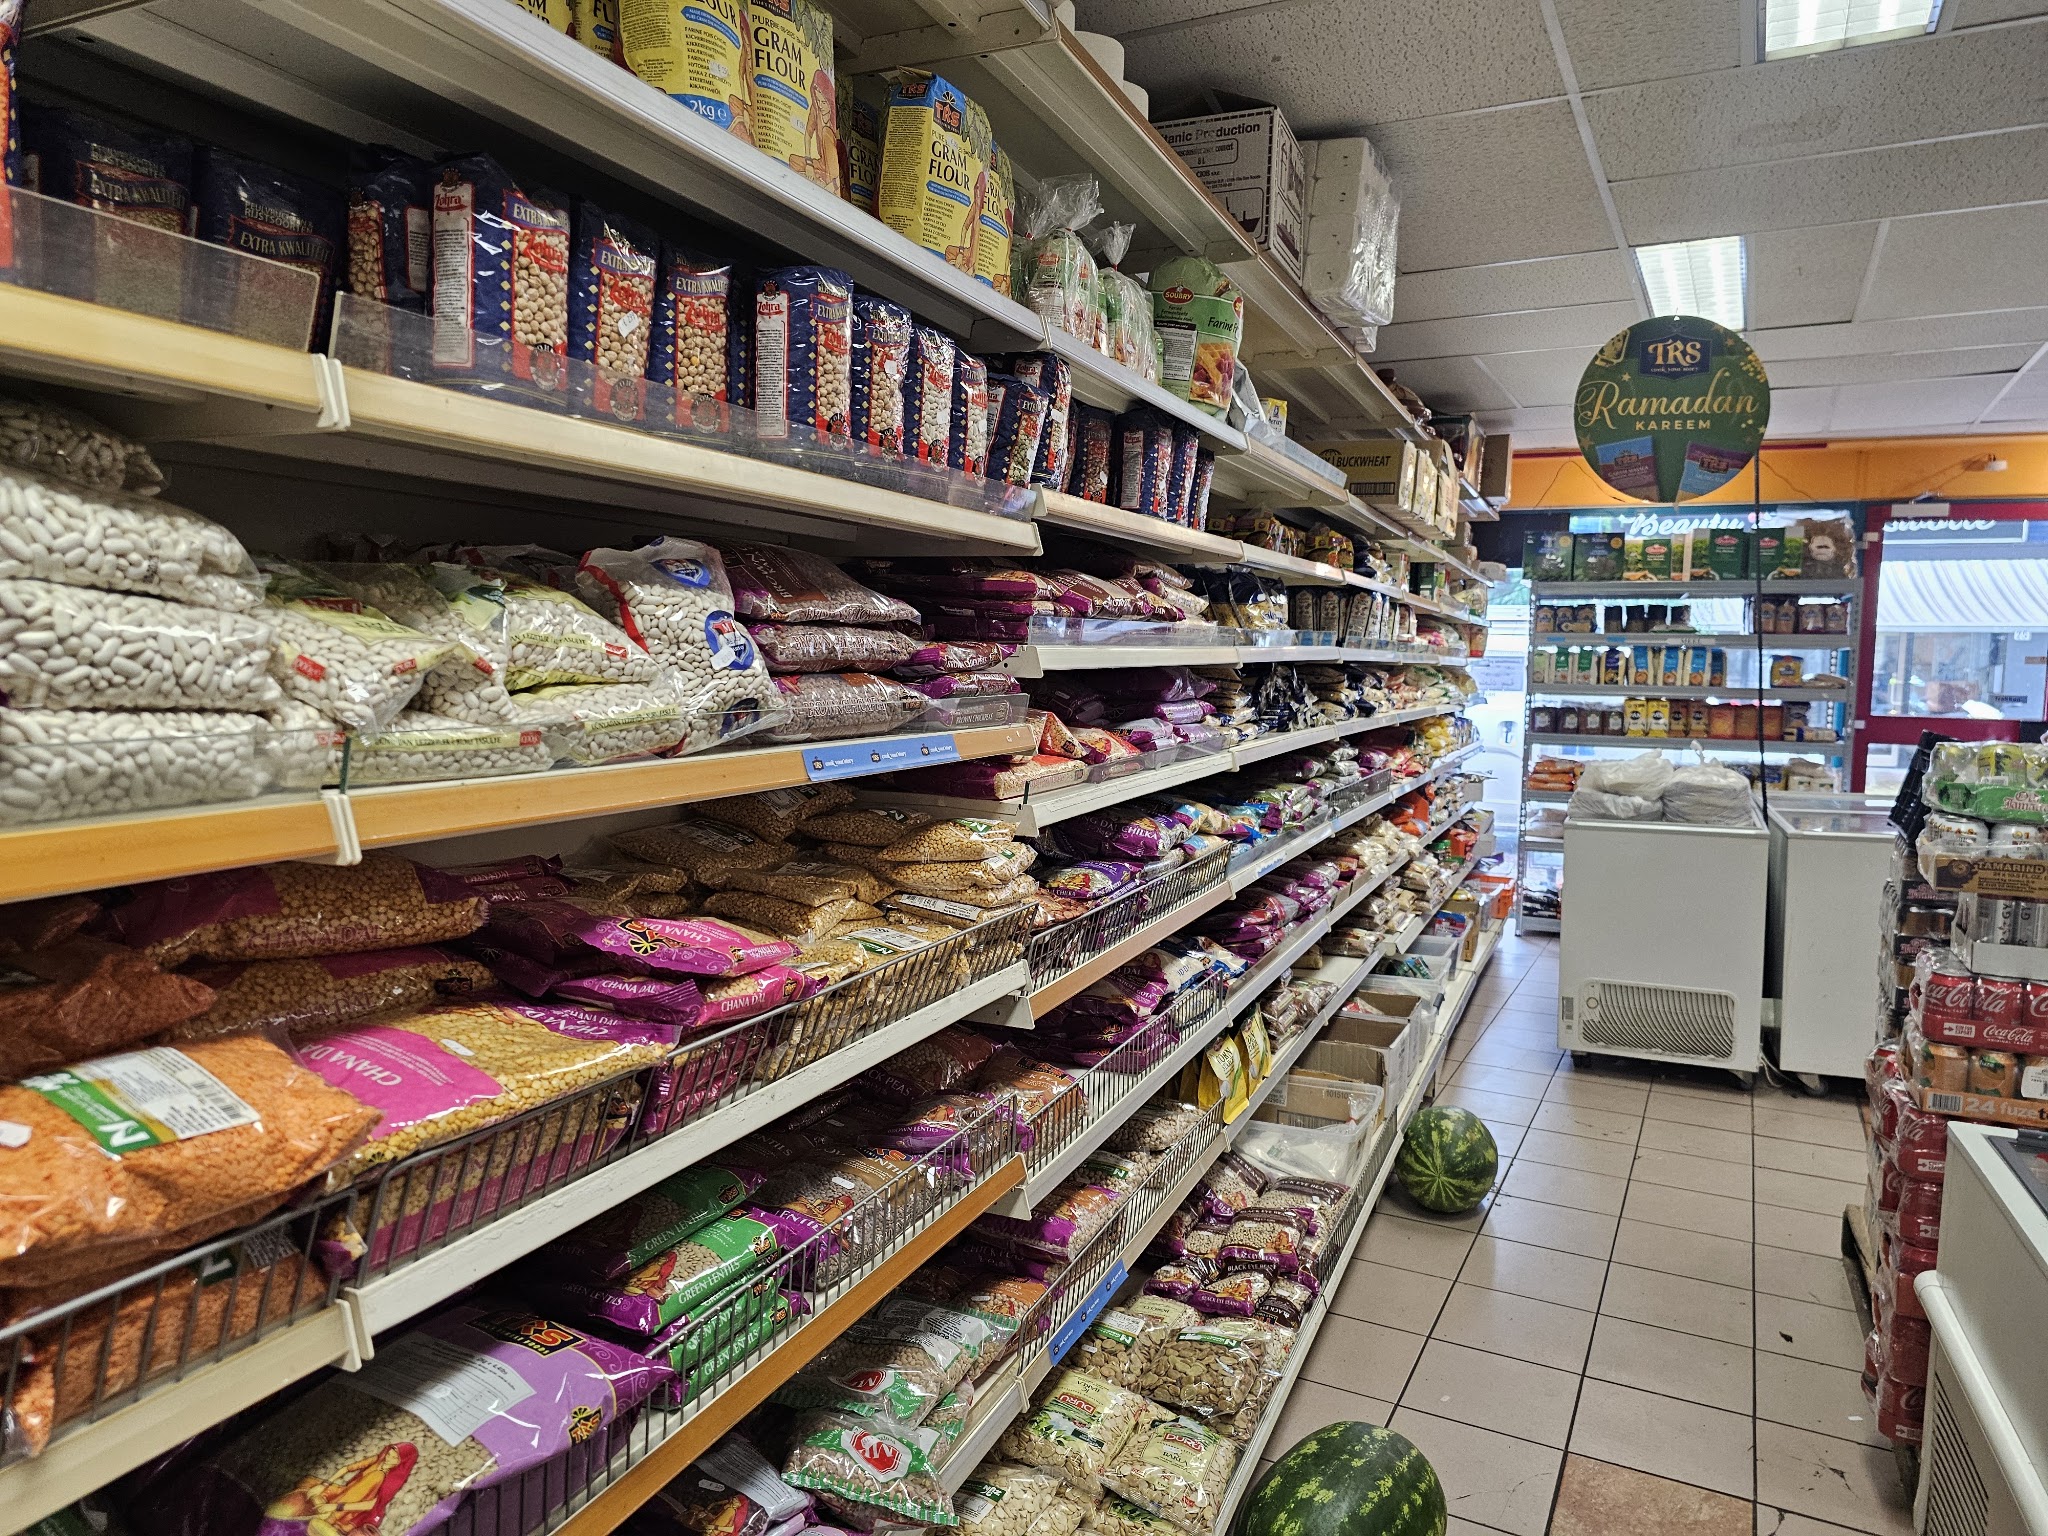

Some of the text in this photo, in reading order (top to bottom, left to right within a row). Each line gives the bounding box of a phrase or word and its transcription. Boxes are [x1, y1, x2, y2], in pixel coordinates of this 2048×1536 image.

[753, 27, 803, 66] GRAM
[754, 48, 806, 91] FLOUR
[902, 83, 927, 94] TRS
[690, 100, 715, 120] 2kg
[935, 101, 961, 127] TRS
[931, 140, 968, 171] GRAM
[850, 163, 876, 186] FLO
[929, 158, 970, 191] FLOUR
[434, 194, 463, 209] Zohra
[513, 202, 541, 226] EXTRA
[239, 231, 331, 263] EXTRA KWALITEIT
[602, 250, 629, 272] EXTRA
[676, 277, 701, 295] EXTRA
[1165, 291, 1192, 301] SOUBRY
[757, 301, 783, 314] Zohra
[1207, 316, 1234, 331] Farine
[1648, 339, 1702, 366] TRS
[1016, 363, 1039, 375] Zohra
[1577, 367, 1760, 430] Ramadan
[1635, 420, 1711, 431] KAREEM
[1338, 455, 1391, 468] BUCKWHEAT
[1100, 820, 1158, 840] DAL CHILKA
[1979, 861, 2045, 874] TAMARIND
[249, 924, 383, 950] CHANA DAL
[666, 922, 712, 945] CHANA
[1123, 966, 1141, 976] DAL
[602, 979, 656, 995] CHANA DAL
[721, 993, 766, 1013] CHANA DAL
[301, 1044, 402, 1086] CHANA DA
[885, 1075, 912, 1097] PEAS
[1967, 1097, 1997, 1115] 24
[751, 1132, 792, 1157] ENTILS
[1311, 1184, 1338, 1195] BEANS
[645, 1229, 675, 1251] GREEN
[1227, 1263, 1246, 1272] BLACK
[678, 1261, 741, 1305] GREEN LENTILS
[590, 1290, 623, 1306] LENTILS
[1201, 1295, 1218, 1303] BLACK
[524, 1337, 550, 1355] FOODS
[1059, 1394, 1095, 1415] DURU
[571, 1415, 601, 1443] TRS
[1165, 1432, 1203, 1453] DURU
